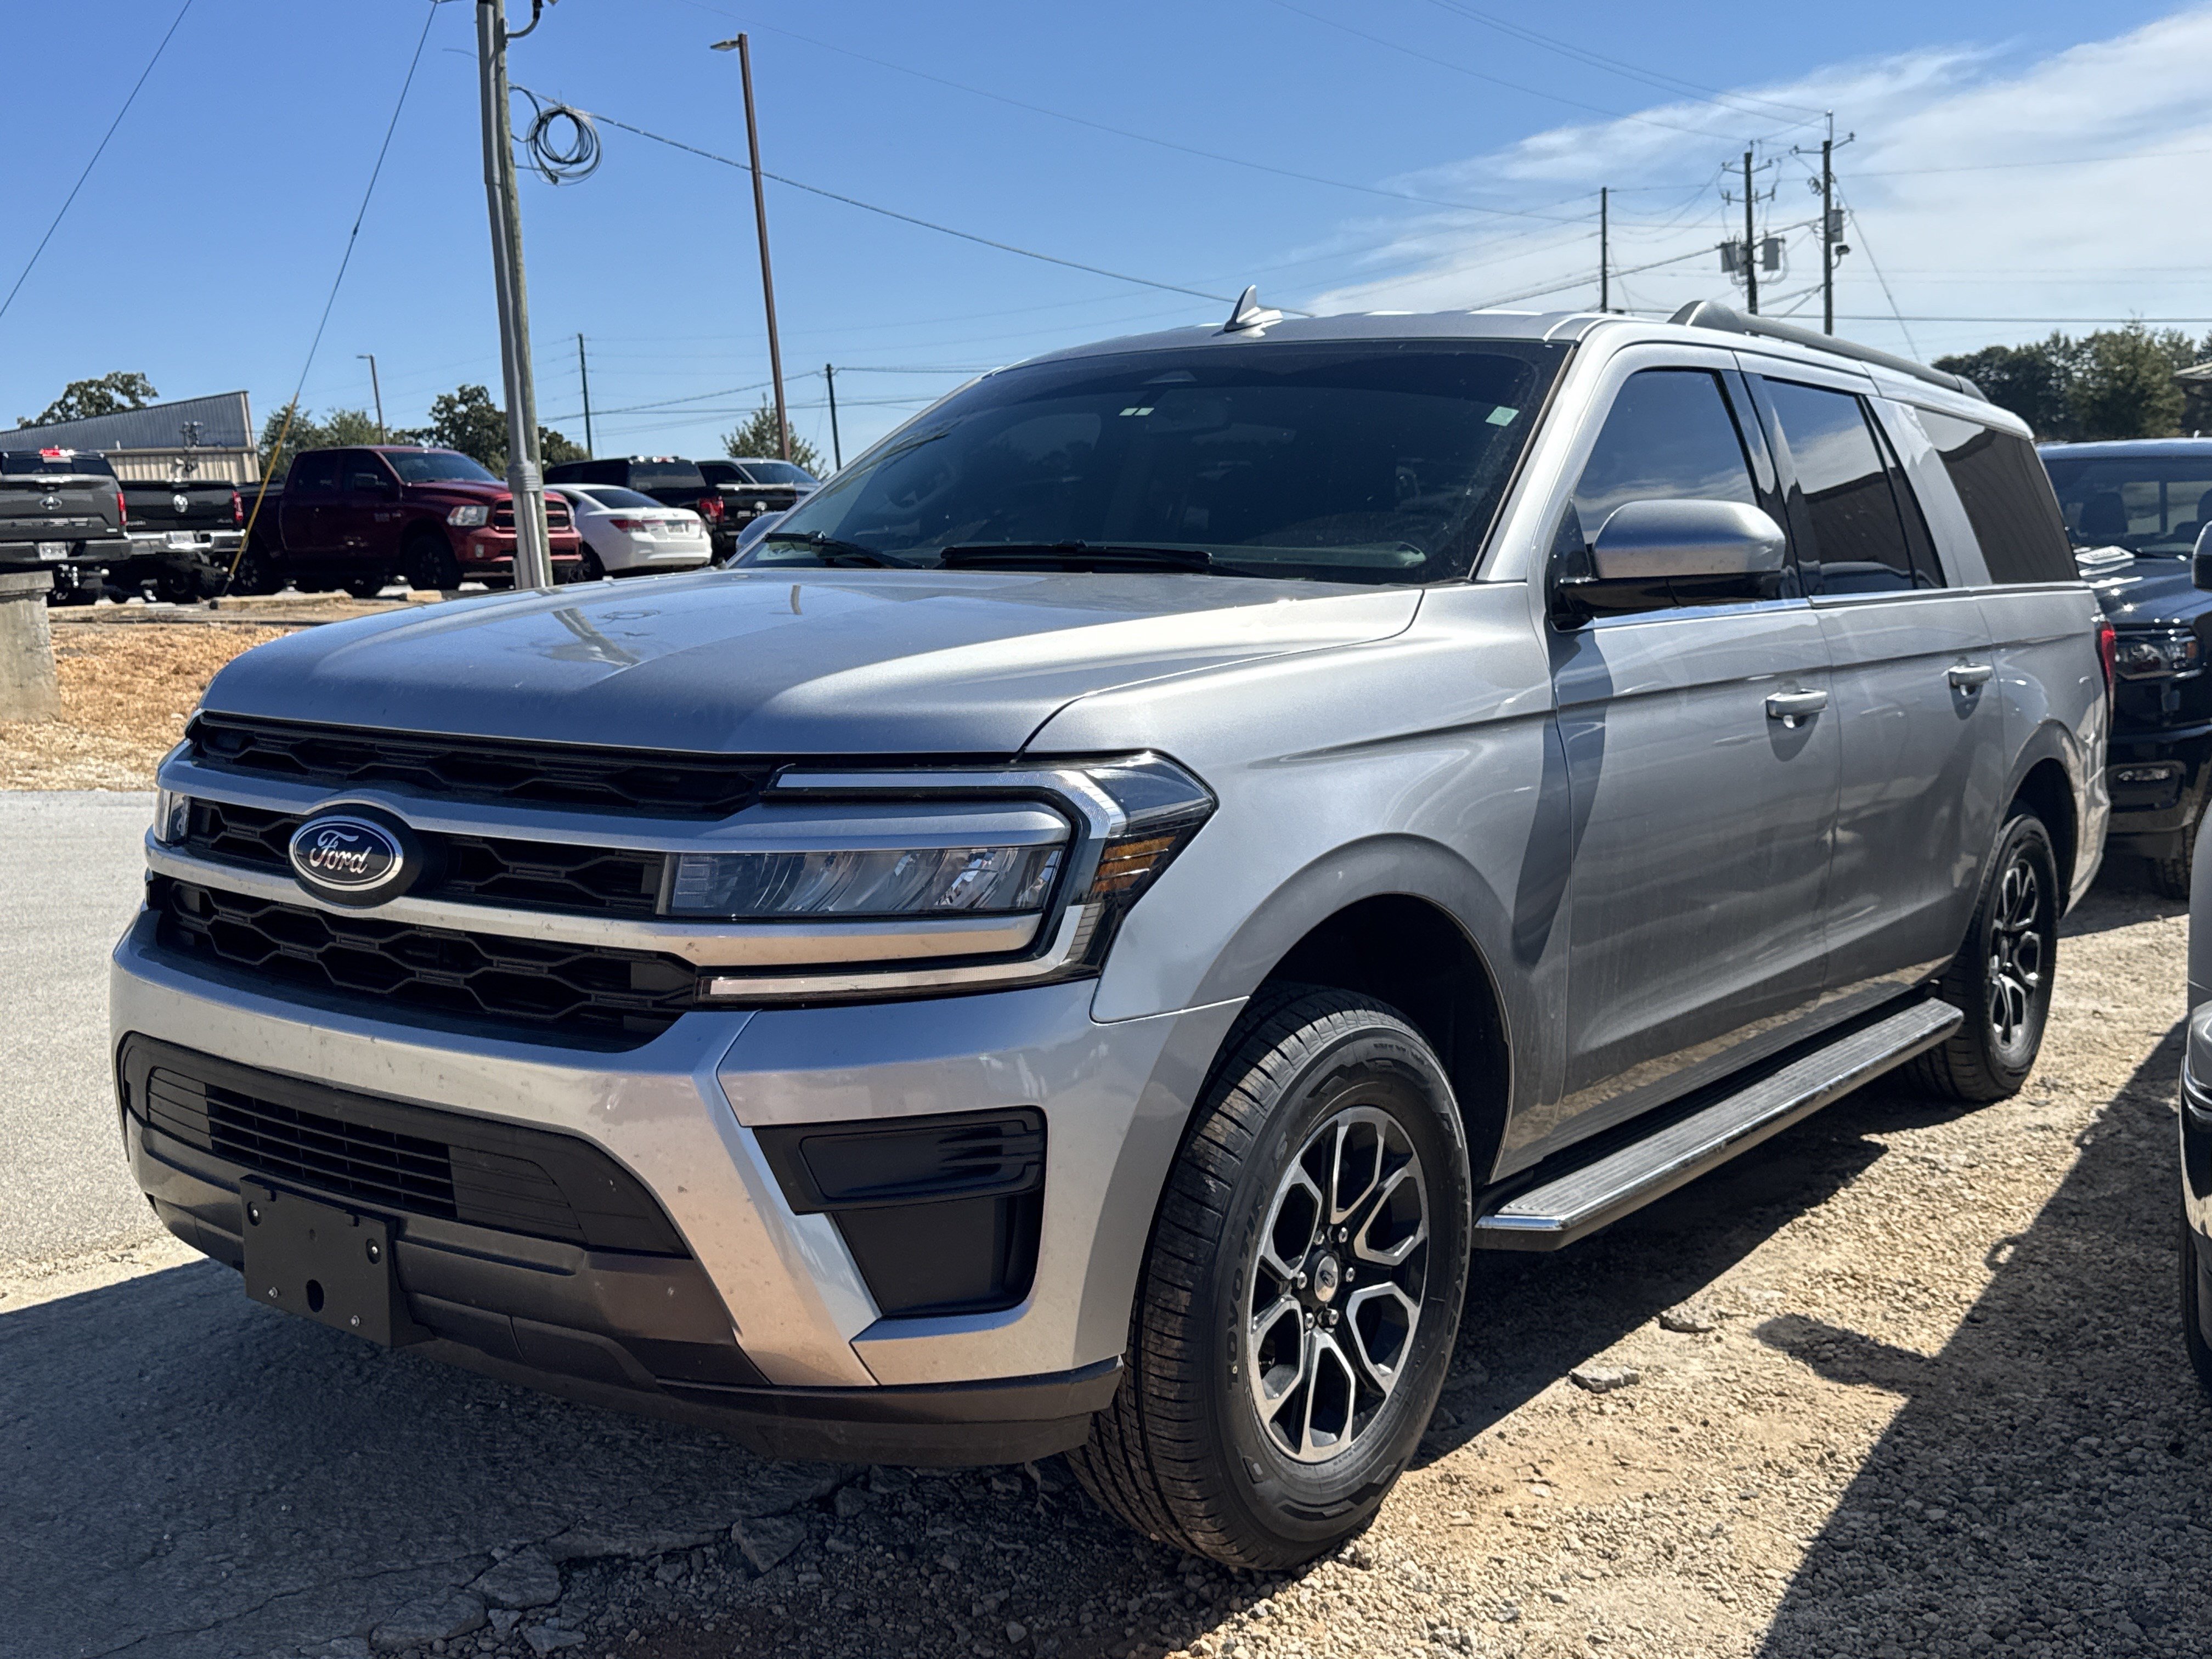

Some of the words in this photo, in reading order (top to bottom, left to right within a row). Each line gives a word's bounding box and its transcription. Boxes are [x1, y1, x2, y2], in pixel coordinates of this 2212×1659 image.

[309, 829, 373, 874] Ford
[1226, 1267, 1244, 1392] TOYO
[1239, 1130, 1289, 1260] TIRS
